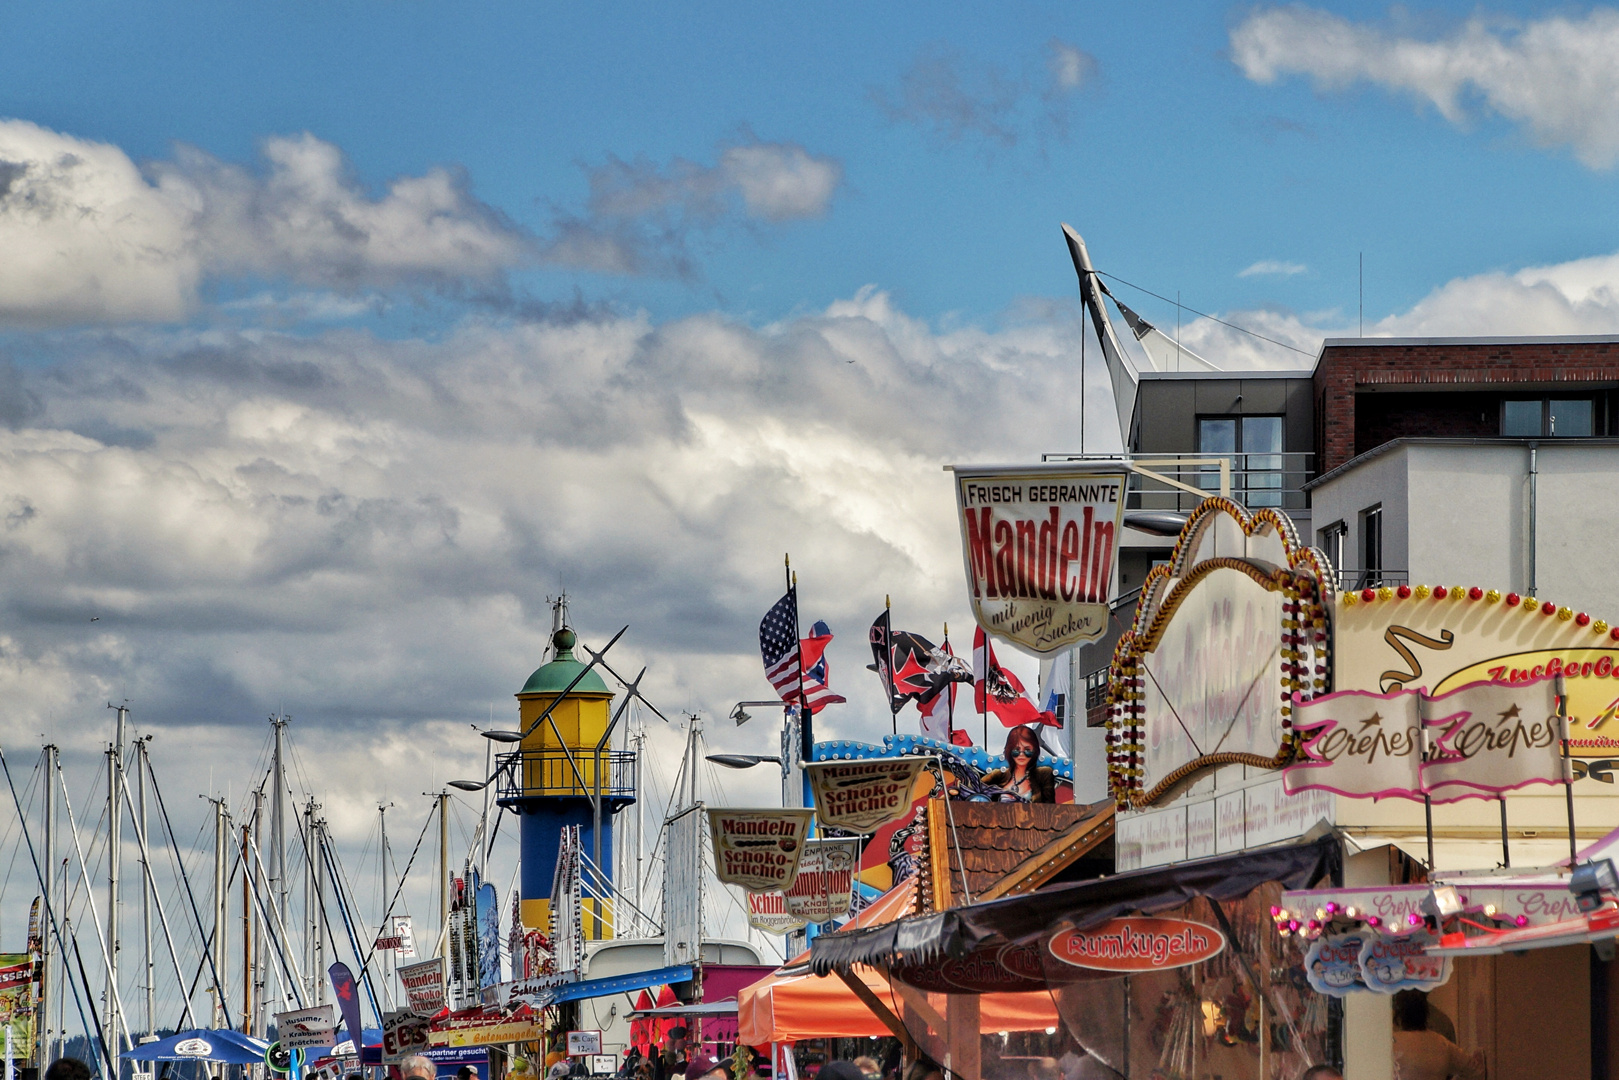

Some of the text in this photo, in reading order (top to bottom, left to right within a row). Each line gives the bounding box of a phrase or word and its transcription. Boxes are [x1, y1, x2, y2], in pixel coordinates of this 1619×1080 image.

[968, 485, 1119, 504] FRISCH GEBRANNTE
[965, 506, 1115, 604] Mandeln
[992, 602, 1017, 624] mit
[1011, 606, 1054, 634] wenig
[1033, 616, 1092, 647] Zucker
[822, 763, 911, 778] Mandeln
[825, 783, 906, 804] Schoko-
[828, 794, 898, 817] früchte
[722, 820, 796, 836] Mandeln
[724, 850, 793, 866] Schoko-
[726, 862, 785, 880] früchte
[1068, 926, 1208, 966] Rumkugeln
[402, 972, 442, 988] Mandeln
[409, 990, 443, 1002] Schoko-
[413, 1000, 441, 1012] früchte
[285, 1016, 322, 1026] Husumer
[473, 1028, 536, 1043] Entenangeln
[581, 1036, 598, 1044] Caps
